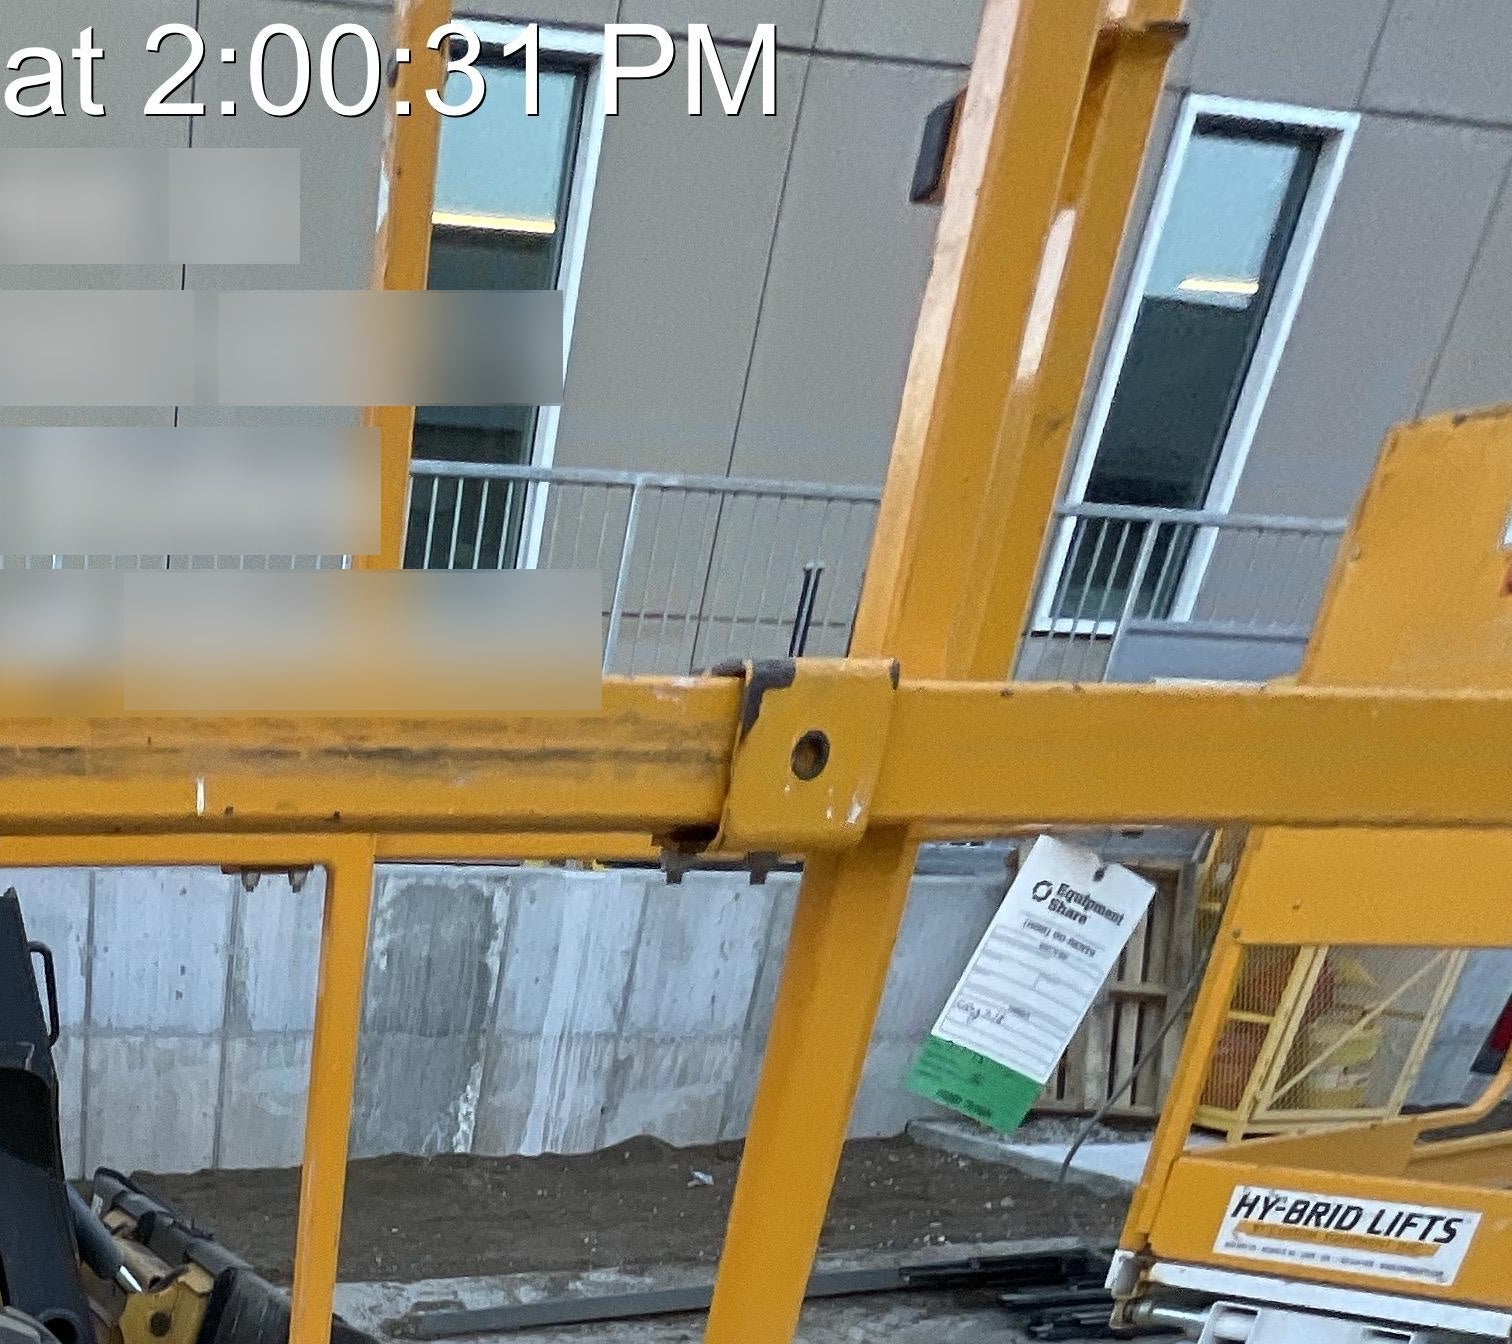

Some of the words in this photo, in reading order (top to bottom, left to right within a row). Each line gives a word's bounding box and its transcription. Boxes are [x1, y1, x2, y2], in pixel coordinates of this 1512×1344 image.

[1048, 898, 1087, 925] Share
[1057, 883, 1124, 926] Equipment
[1231, 1192, 1364, 1231] HY-BRID
[1367, 1209, 1464, 1244] LIFTS
